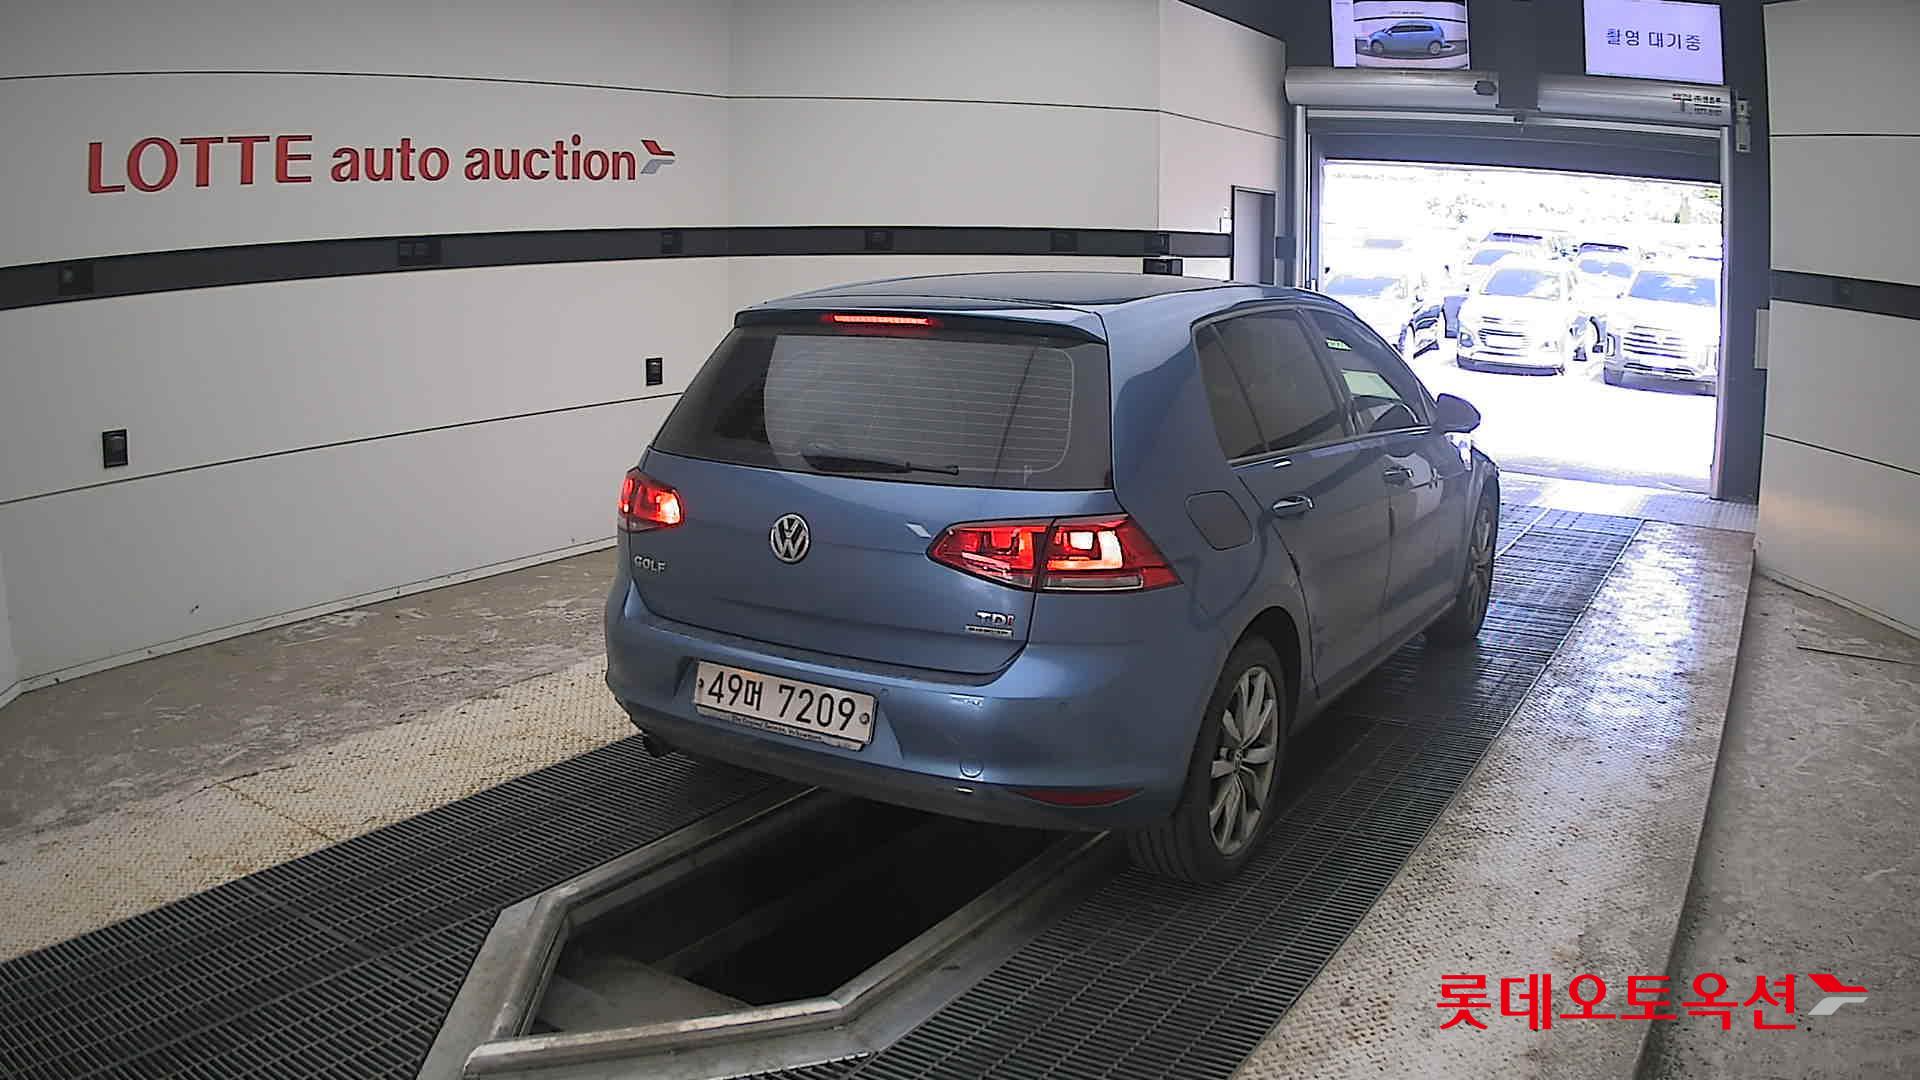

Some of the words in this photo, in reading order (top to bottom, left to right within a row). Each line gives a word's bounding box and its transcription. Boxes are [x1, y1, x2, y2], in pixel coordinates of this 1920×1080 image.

[1648, 31, 1701, 51] 대기중
[87, 134, 313, 194] LOTTE
[330, 137, 450, 182] auto
[463, 133, 638, 182] auction
[633, 555, 666, 573] GOLF
[976, 610, 1016, 626] TDI
[708, 671, 763, 712] 49머
[778, 684, 856, 731] 7209
